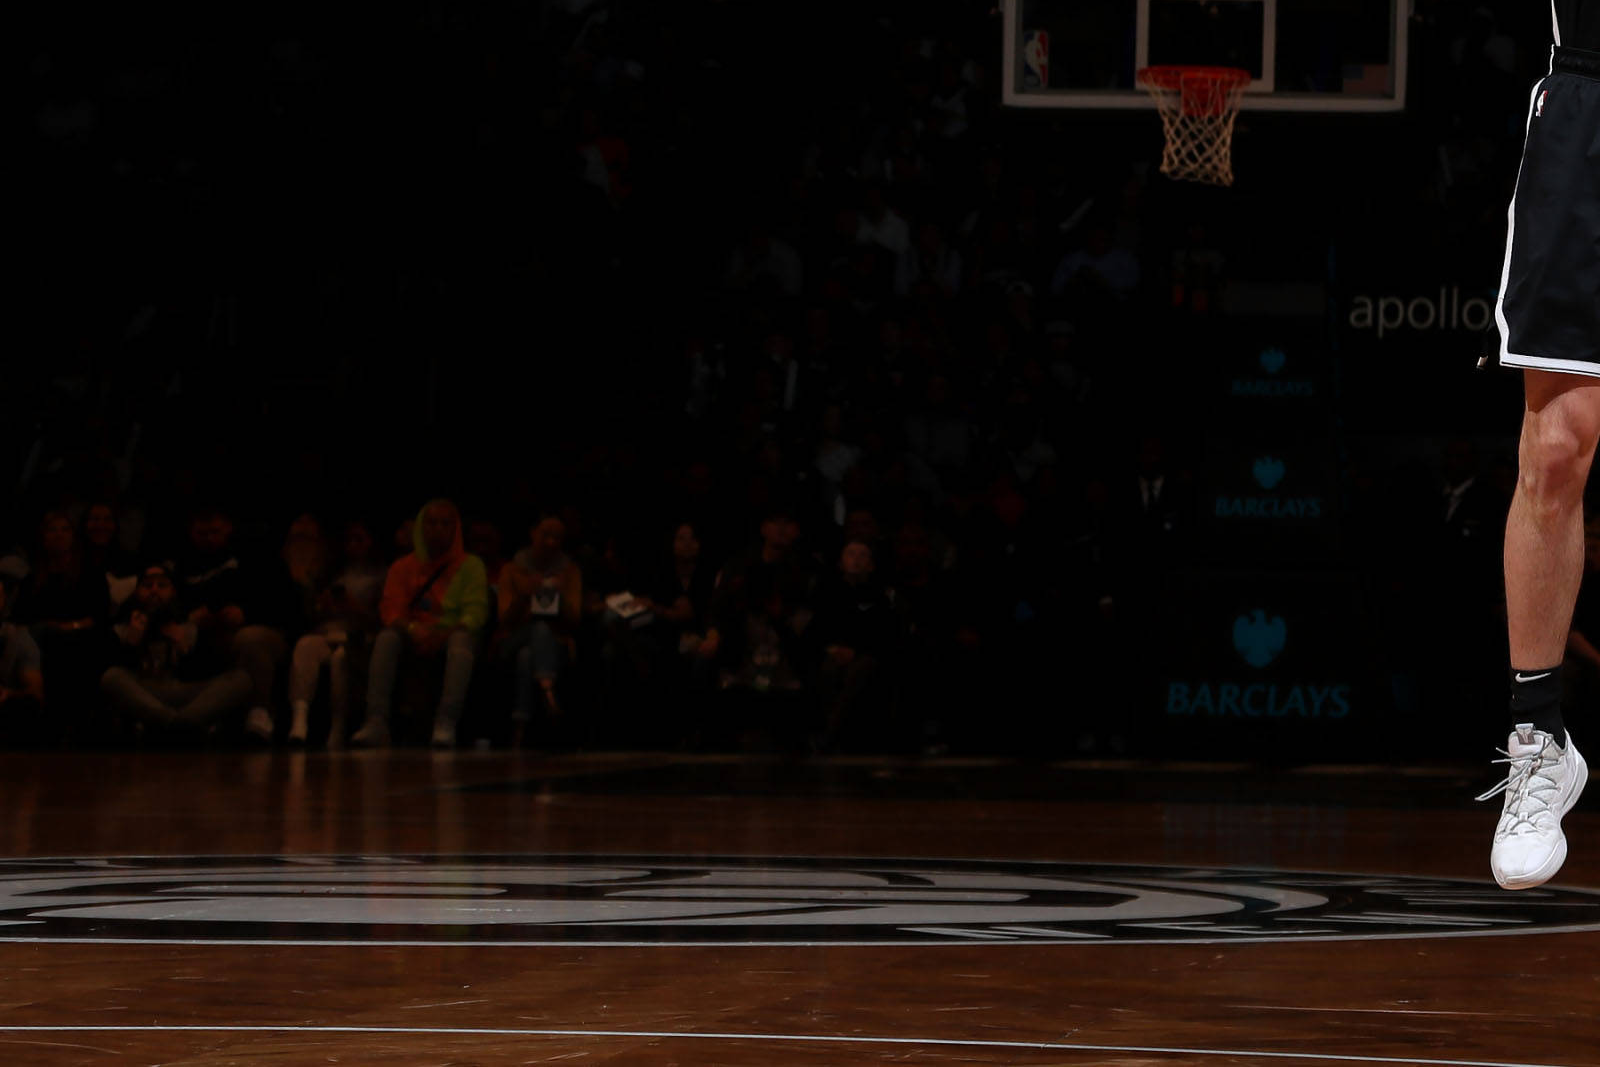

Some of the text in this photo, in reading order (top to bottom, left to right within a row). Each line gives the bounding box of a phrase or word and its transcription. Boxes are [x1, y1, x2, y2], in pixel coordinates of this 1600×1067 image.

[1348, 285, 1490, 338] apollo
[1215, 495, 1322, 519] BARCLAYS
[1165, 679, 1352, 720] BARCLAYS
